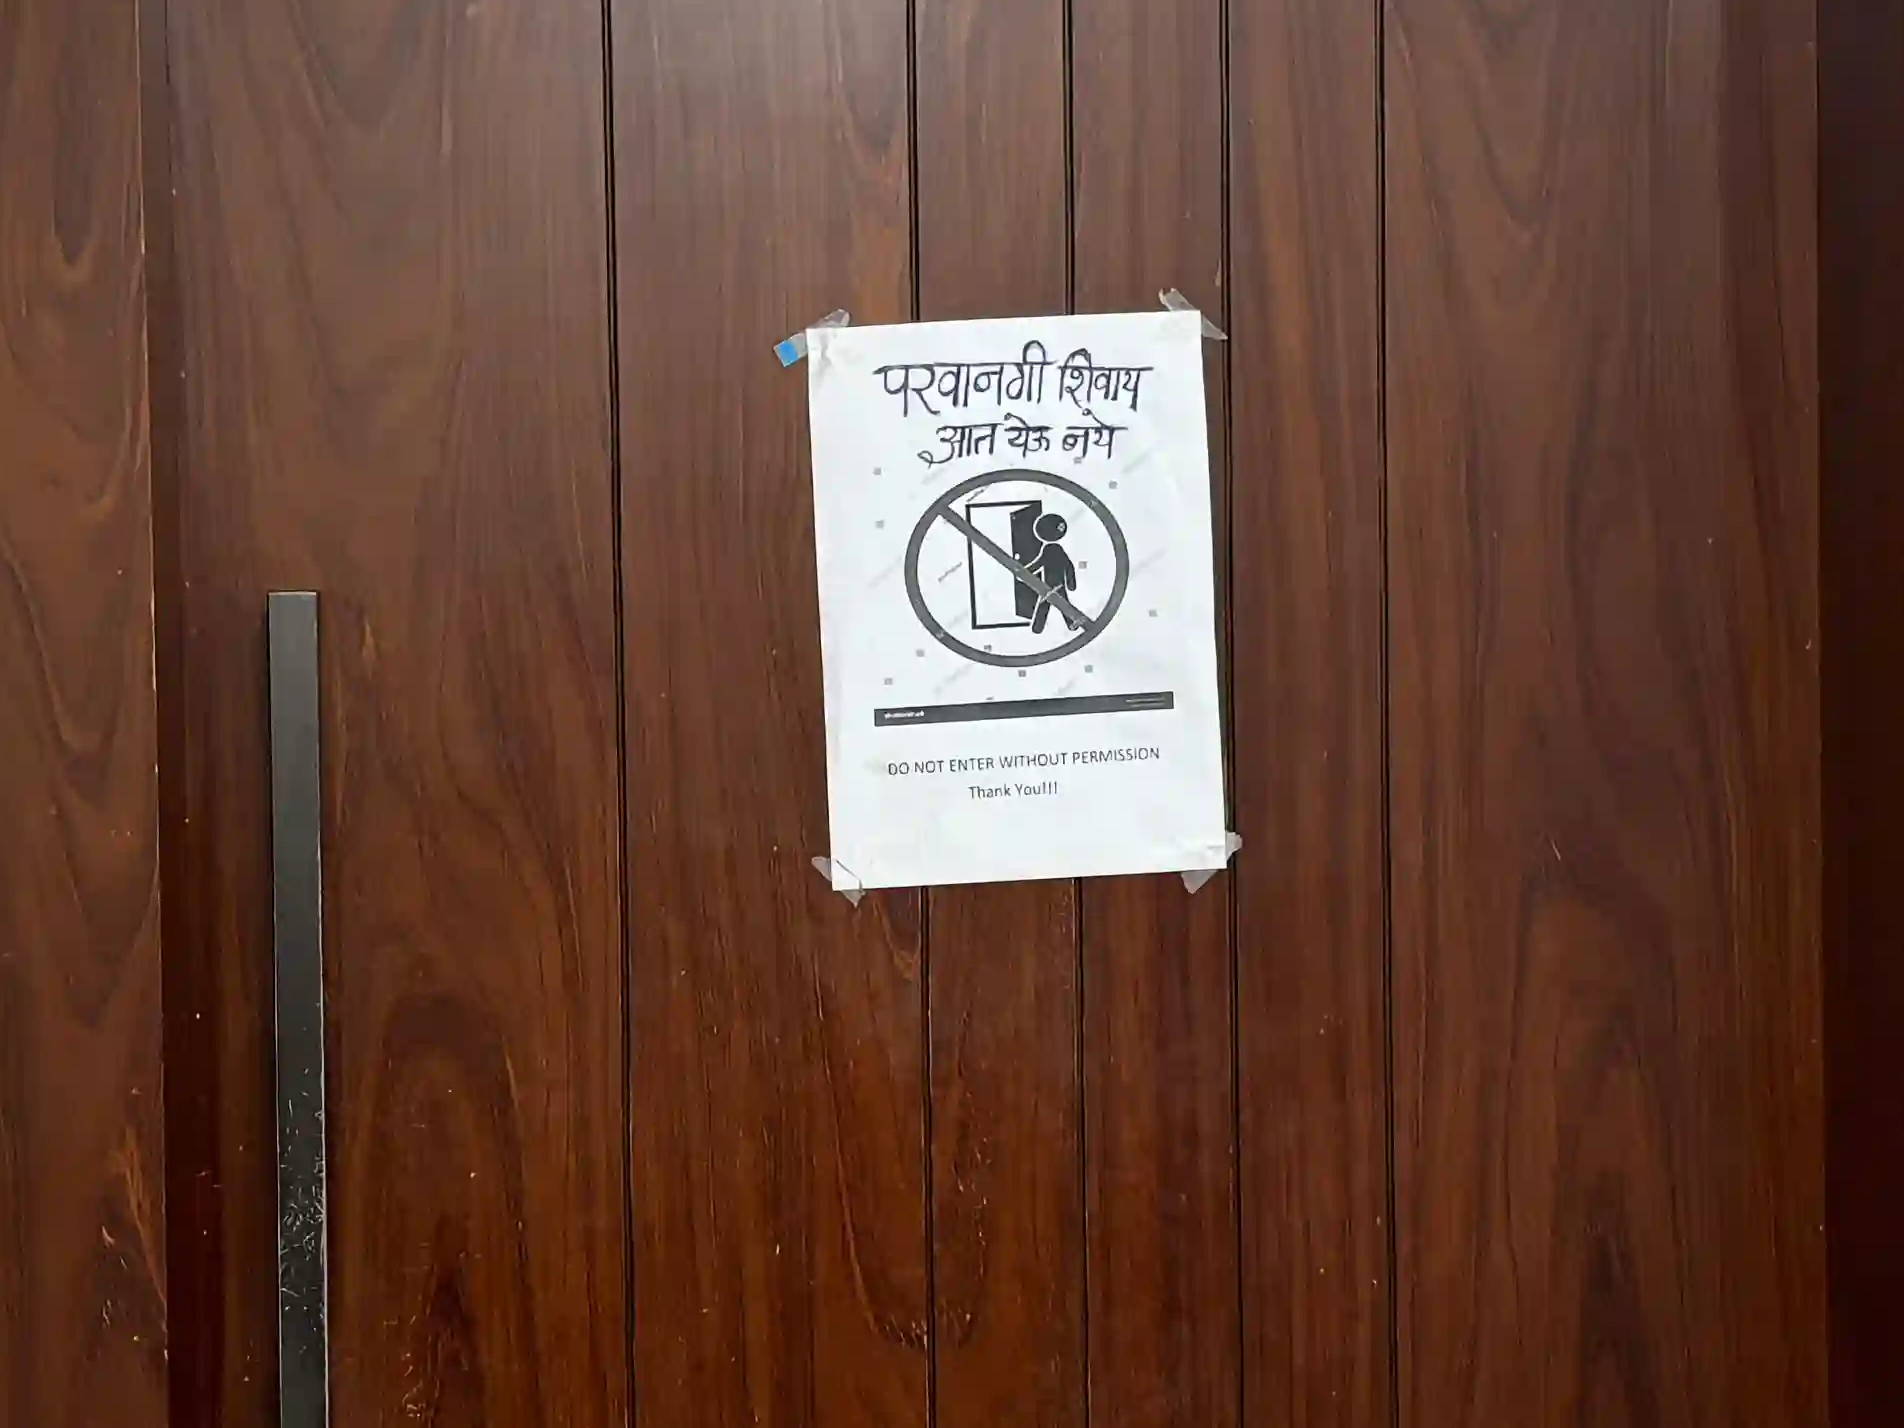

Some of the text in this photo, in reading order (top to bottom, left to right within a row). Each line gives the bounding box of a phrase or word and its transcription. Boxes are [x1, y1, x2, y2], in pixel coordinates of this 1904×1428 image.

[873, 340, 1057, 417] परवानगी
[918, 422, 1003, 468] आत
[1062, 409, 1129, 460] नये
[888, 747, 1160, 776] DO NOT ENTER WITHOUT PERMISSION
[969, 781, 1058, 799] Thank You!!!
